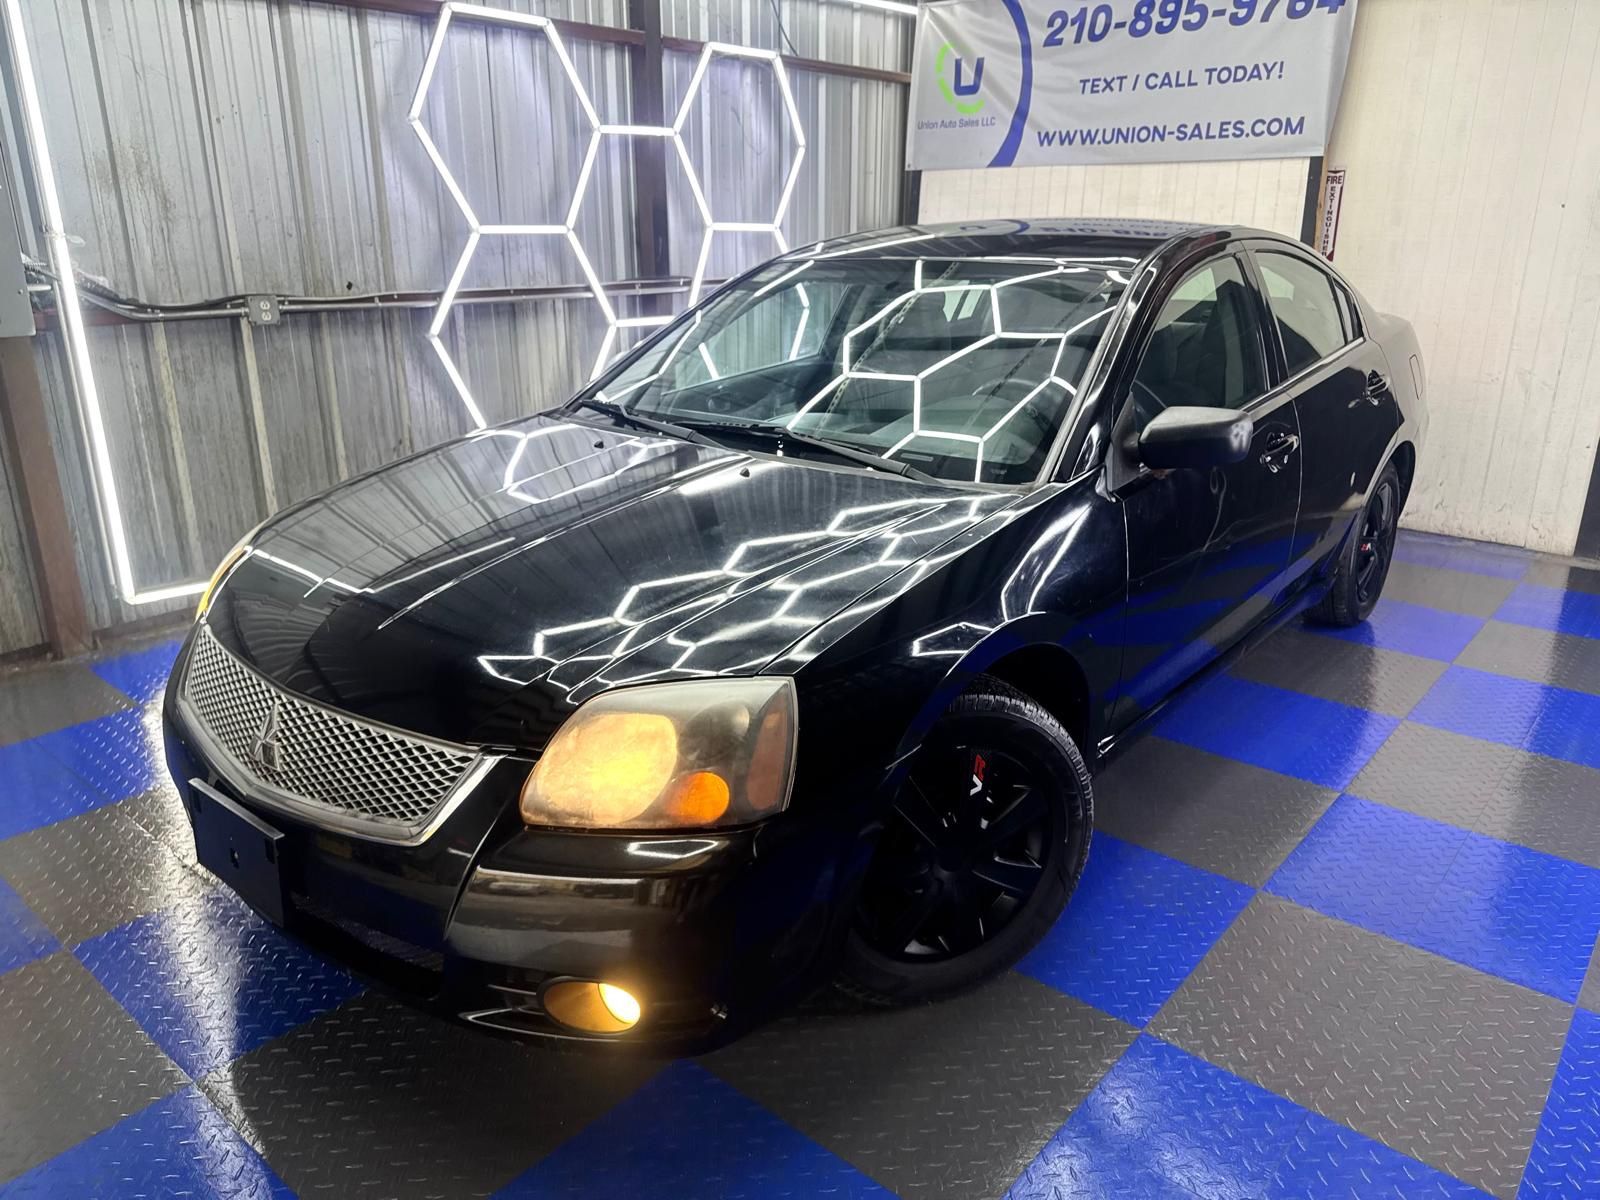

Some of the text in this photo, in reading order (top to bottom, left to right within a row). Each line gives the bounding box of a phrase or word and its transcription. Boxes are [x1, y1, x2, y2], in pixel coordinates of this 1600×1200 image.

[1079, 61, 1284, 95] TEXT / CALL TODAY!
[917, 116, 996, 130] Union Auto Sales LLC
[1037, 116, 1305, 147] WWW.UNION-SALES.COM
[1326, 175, 1343, 184] FIRE
